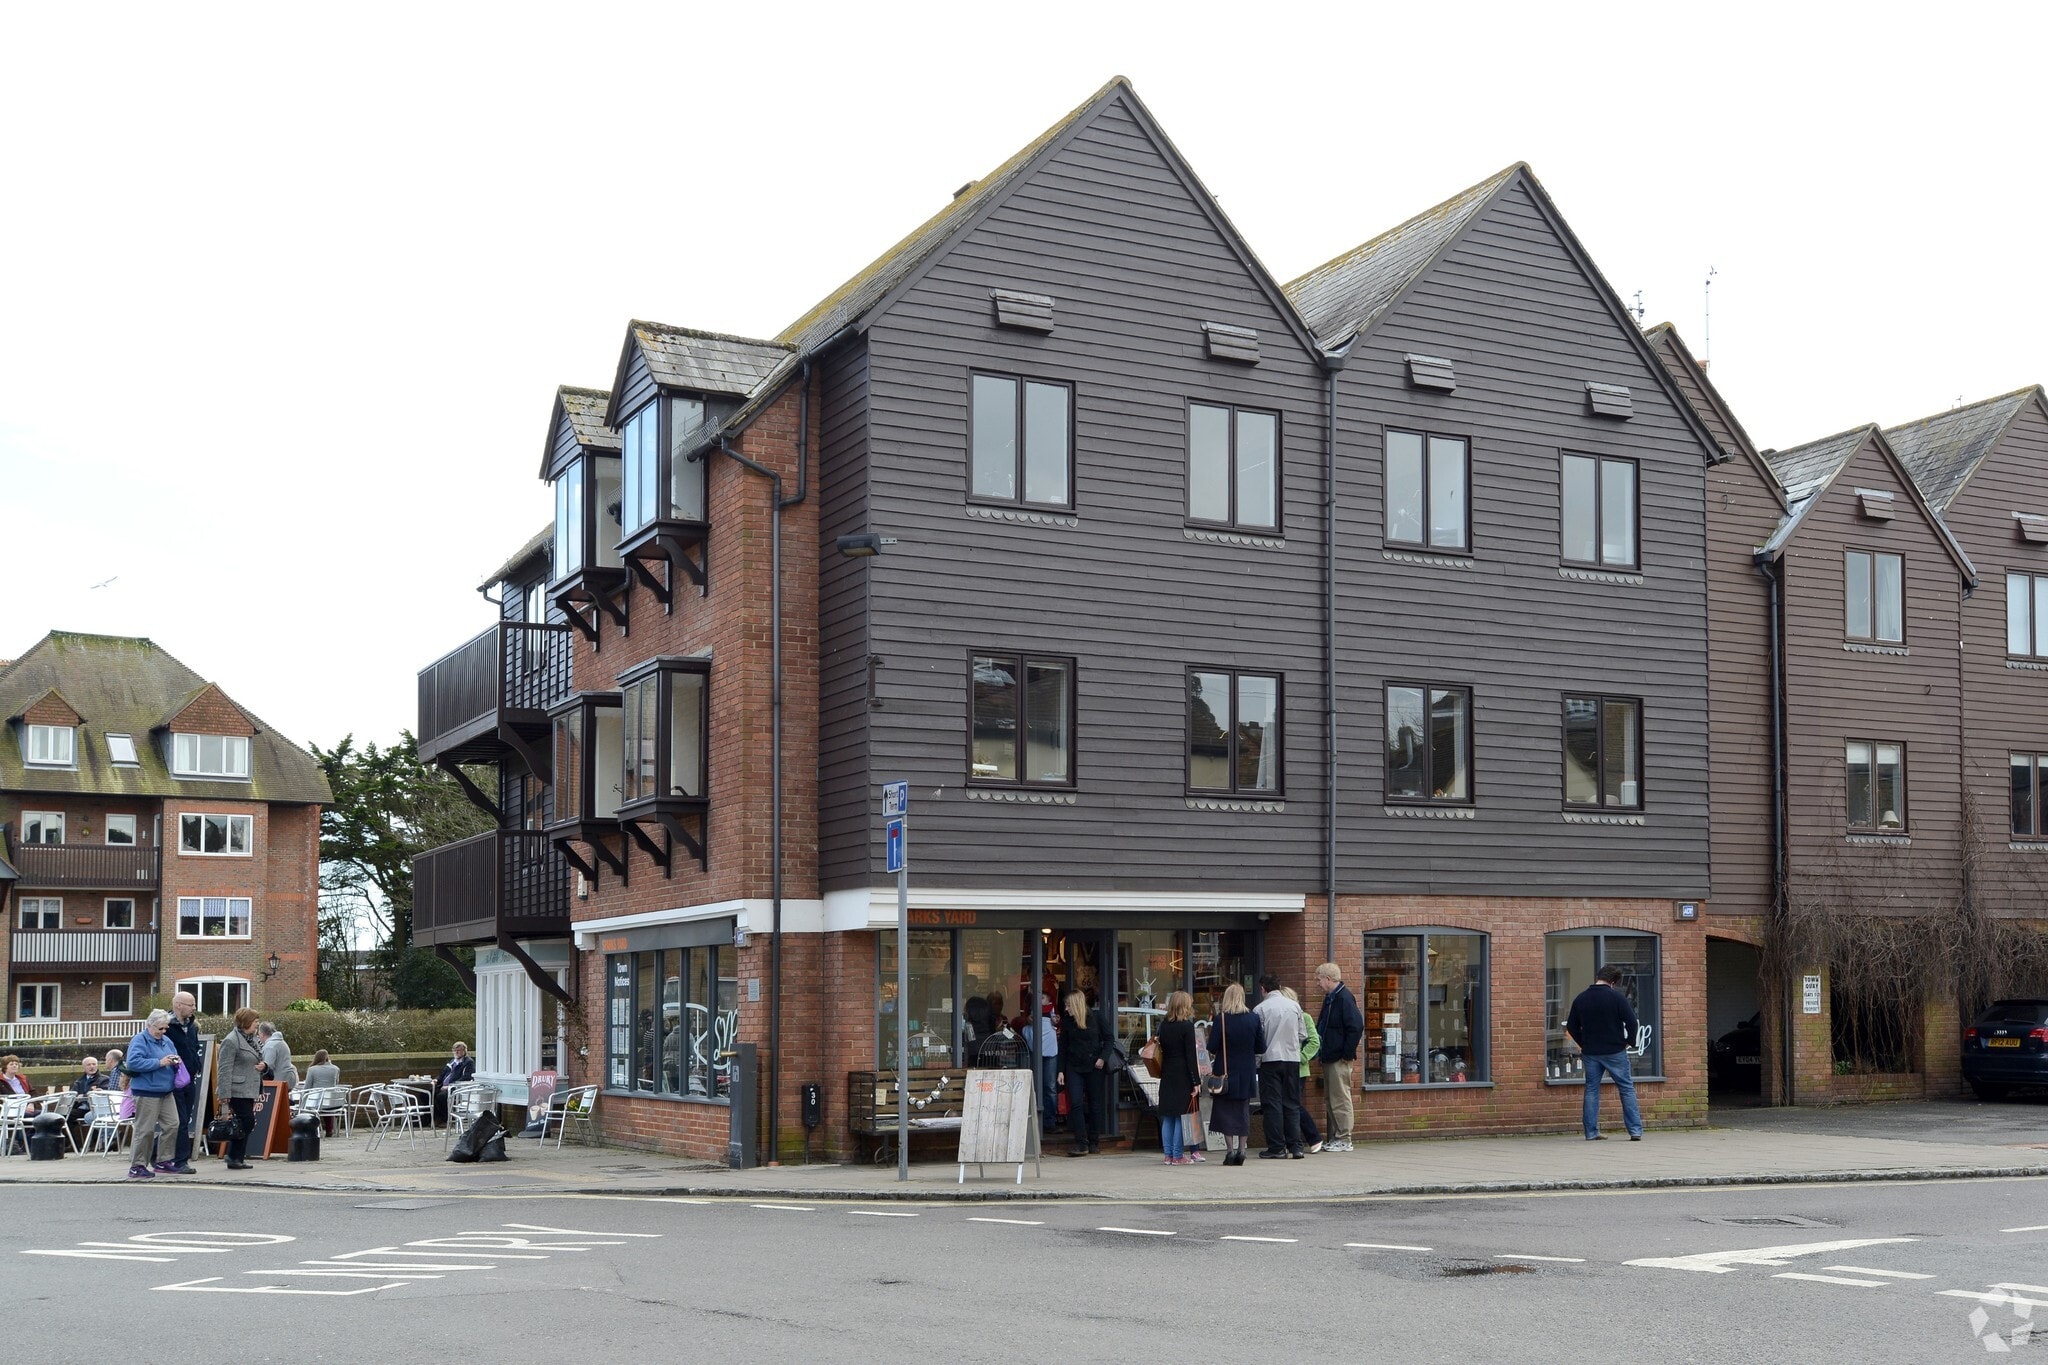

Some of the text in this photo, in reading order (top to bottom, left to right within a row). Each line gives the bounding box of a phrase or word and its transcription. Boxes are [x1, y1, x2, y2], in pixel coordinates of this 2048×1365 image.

[888, 788, 905, 807] Short P
[889, 801, 897, 811] Term
[907, 910, 977, 925] ARKS YARD
[617, 963, 628, 973] Town
[614, 976, 630, 987] Notices
[20, 1231, 297, 1262] NO
[150, 1223, 663, 1296] ENTRY
